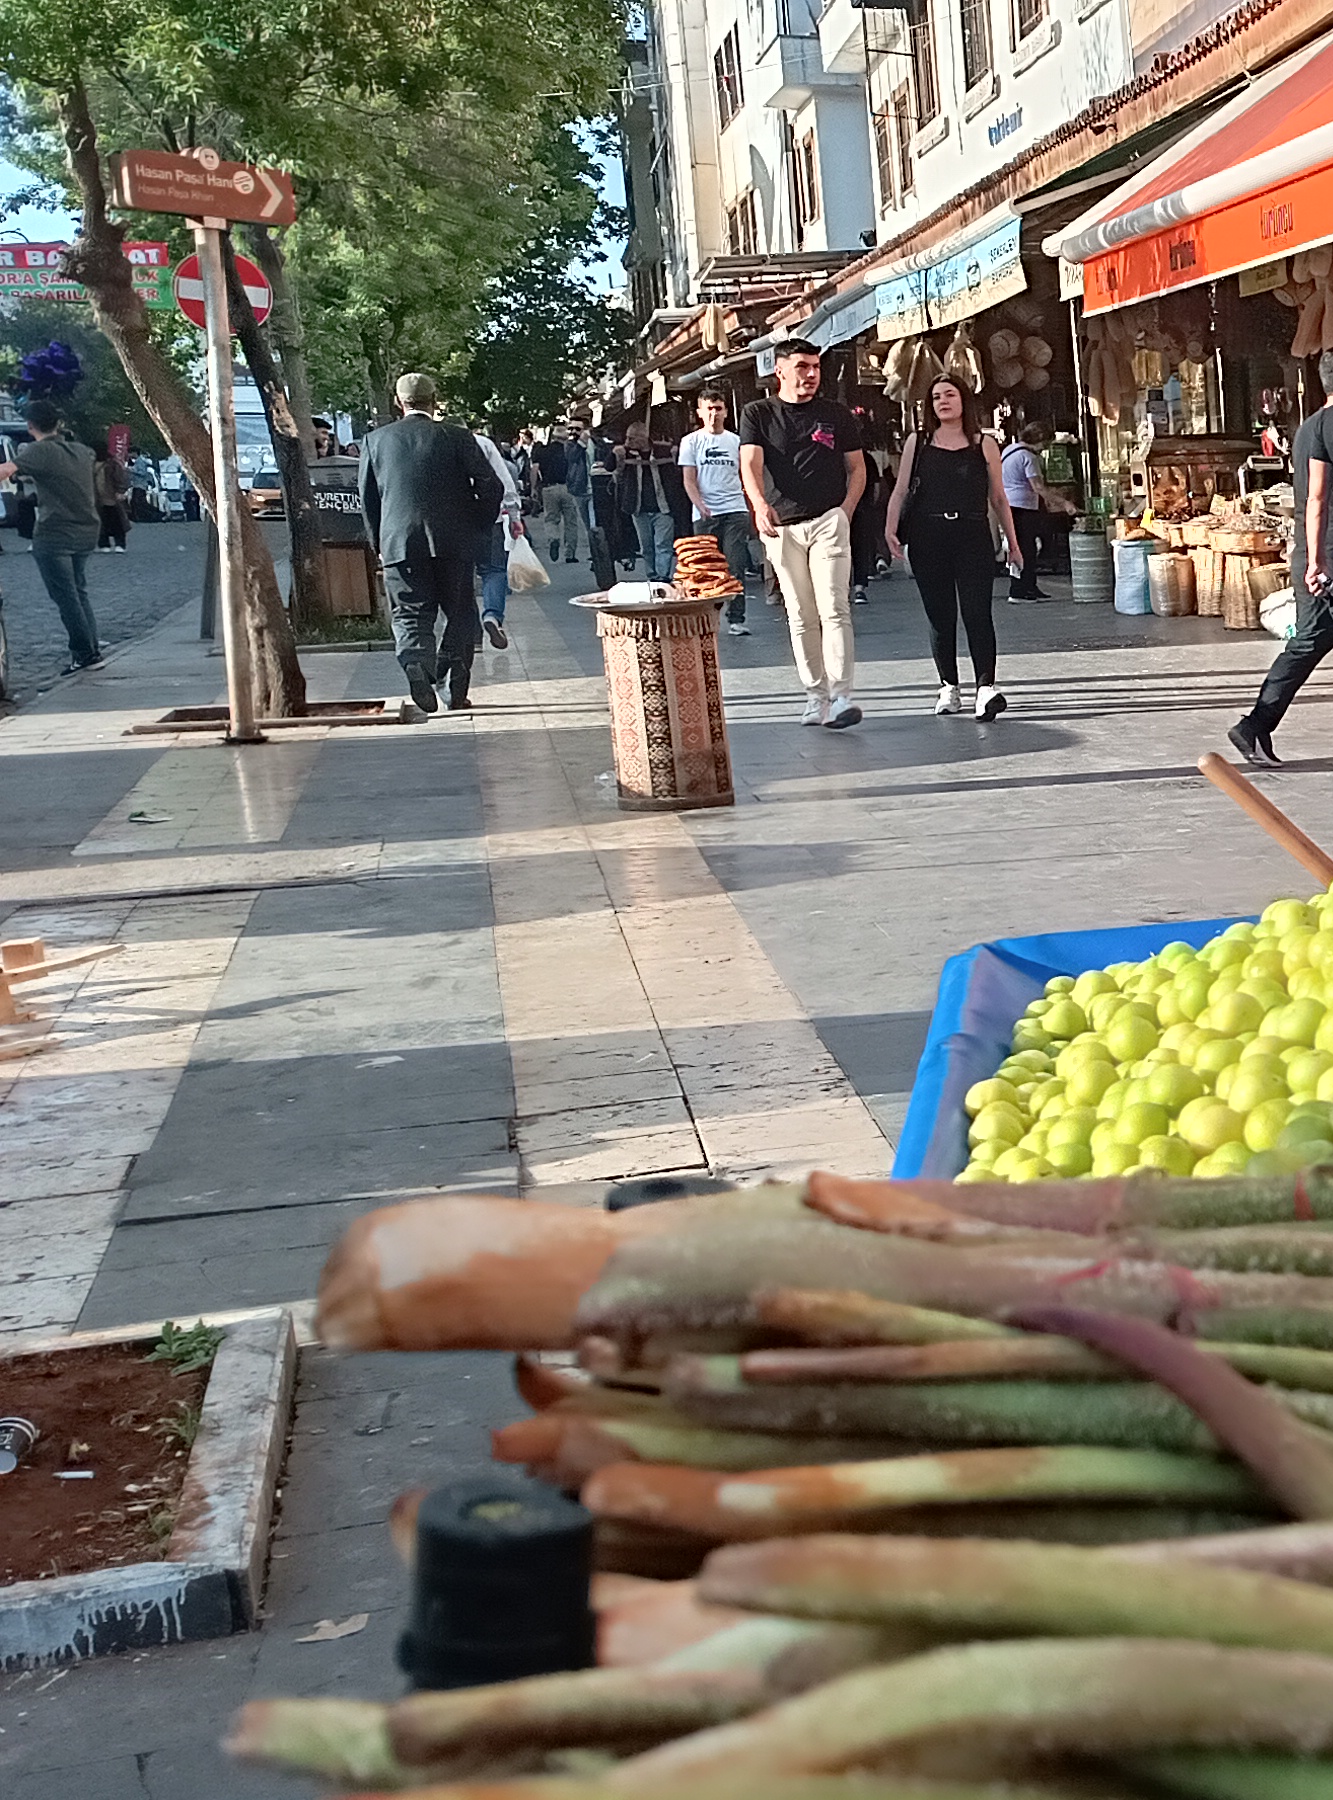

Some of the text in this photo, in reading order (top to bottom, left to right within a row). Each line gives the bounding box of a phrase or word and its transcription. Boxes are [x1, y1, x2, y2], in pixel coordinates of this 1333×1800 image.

[135, 164, 173, 182] Hasan
[175, 169, 205, 186] Paşa
[700, 459, 735, 467] LACOSTE
